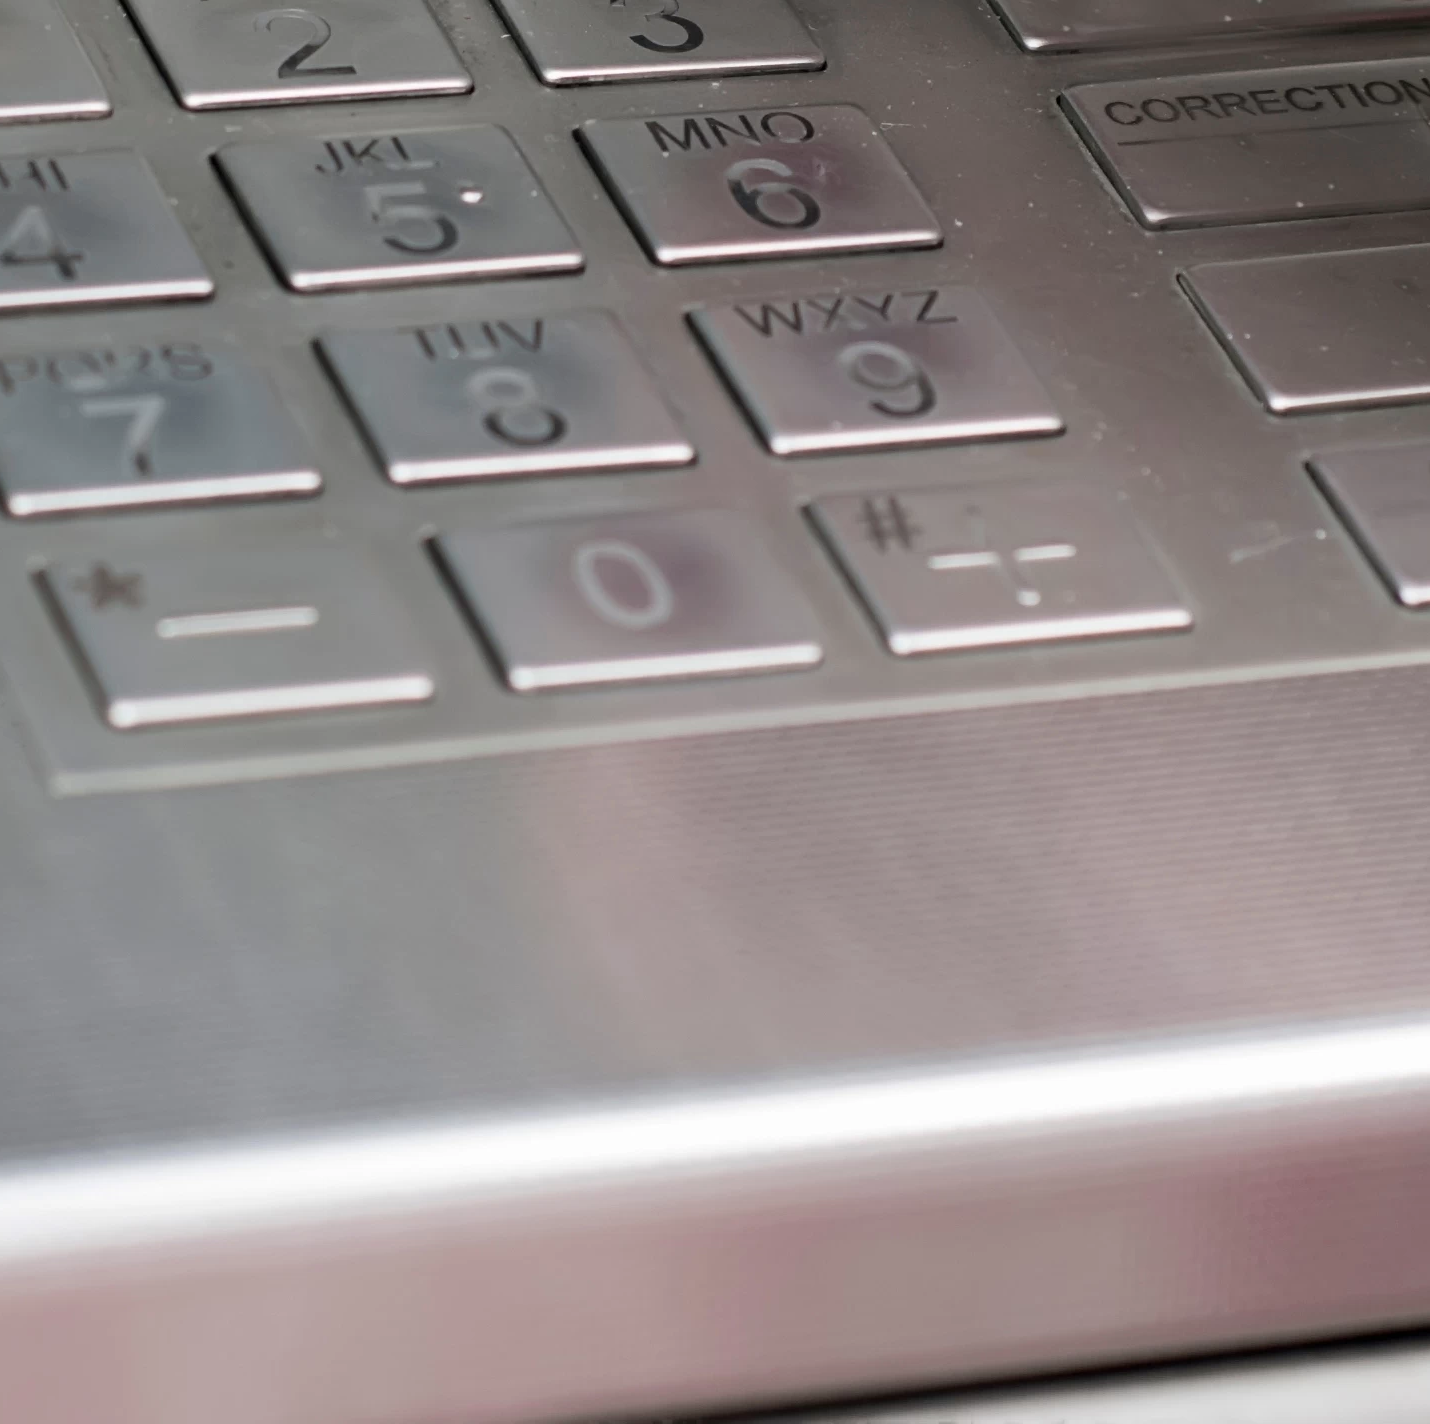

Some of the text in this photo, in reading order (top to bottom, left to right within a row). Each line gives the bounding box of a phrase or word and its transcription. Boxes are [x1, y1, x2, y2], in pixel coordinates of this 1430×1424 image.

[254, 6, 358, 80] 2
[314, 134, 439, 176] JKL
[643, 110, 817, 154] MNO
[362, 181, 460, 256] 5
[725, 156, 822, 231] 6
[407, 317, 547, 362] TUV
[732, 288, 960, 341] WXYZ
[466, 366, 568, 448] 8
[833, 339, 938, 419] 9
[79, 392, 167, 478] 7
[574, 538, 676, 631] 0
